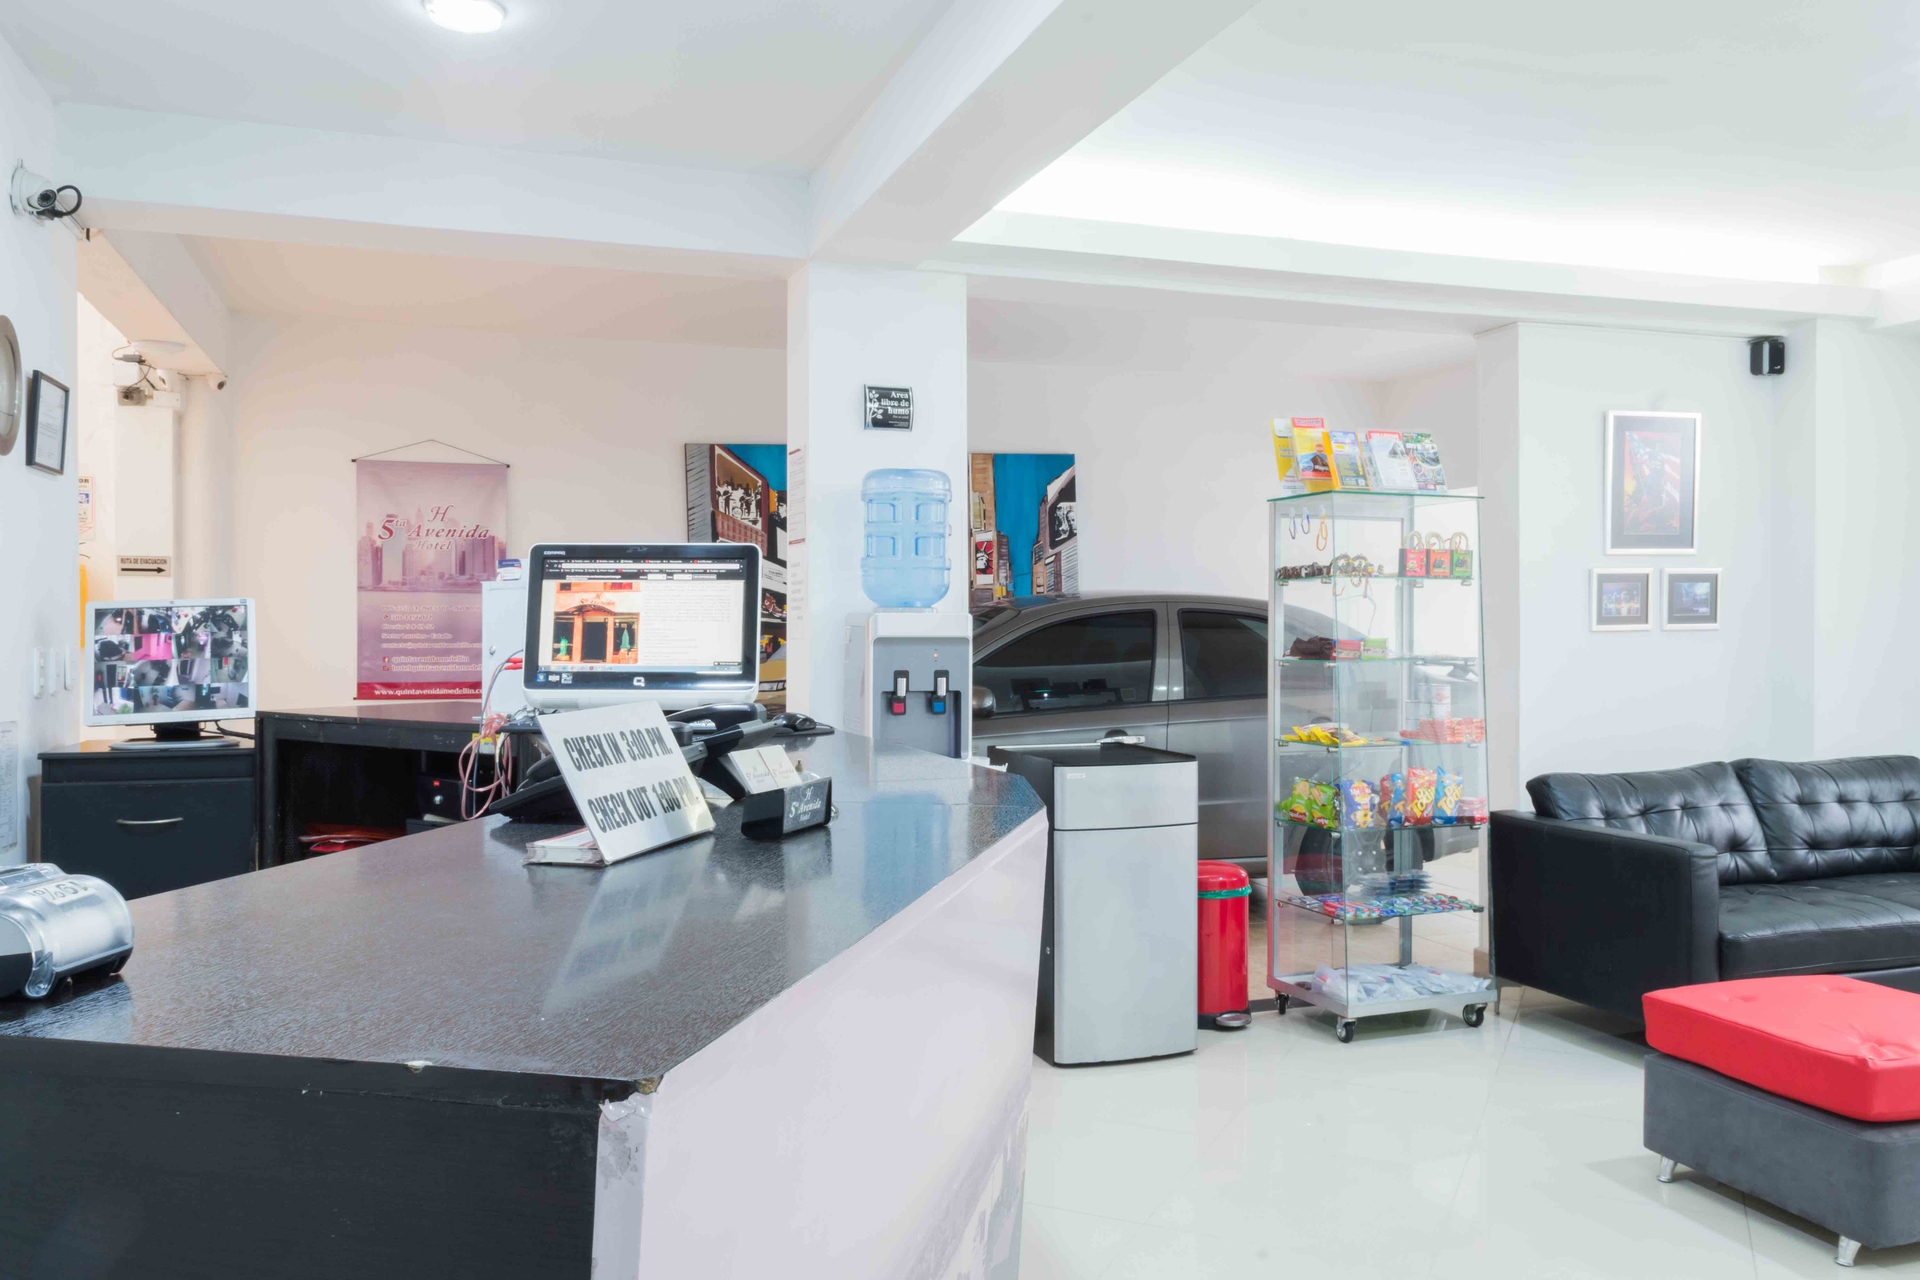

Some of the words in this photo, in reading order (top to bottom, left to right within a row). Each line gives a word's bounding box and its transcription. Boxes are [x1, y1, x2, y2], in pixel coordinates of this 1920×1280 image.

[900, 399, 909, 407] de
[407, 524, 489, 538] Avenida
[414, 540, 452, 550] Hotel
[374, 688, 484, 696] www.quintavenidamedellin.co
[563, 734, 613, 772] CHECK
[603, 732, 626, 764] IN
[620, 728, 653, 761] 3:00
[587, 791, 637, 833] CHECK
[626, 786, 657, 821] OUT
[652, 780, 681, 814] 1:00
